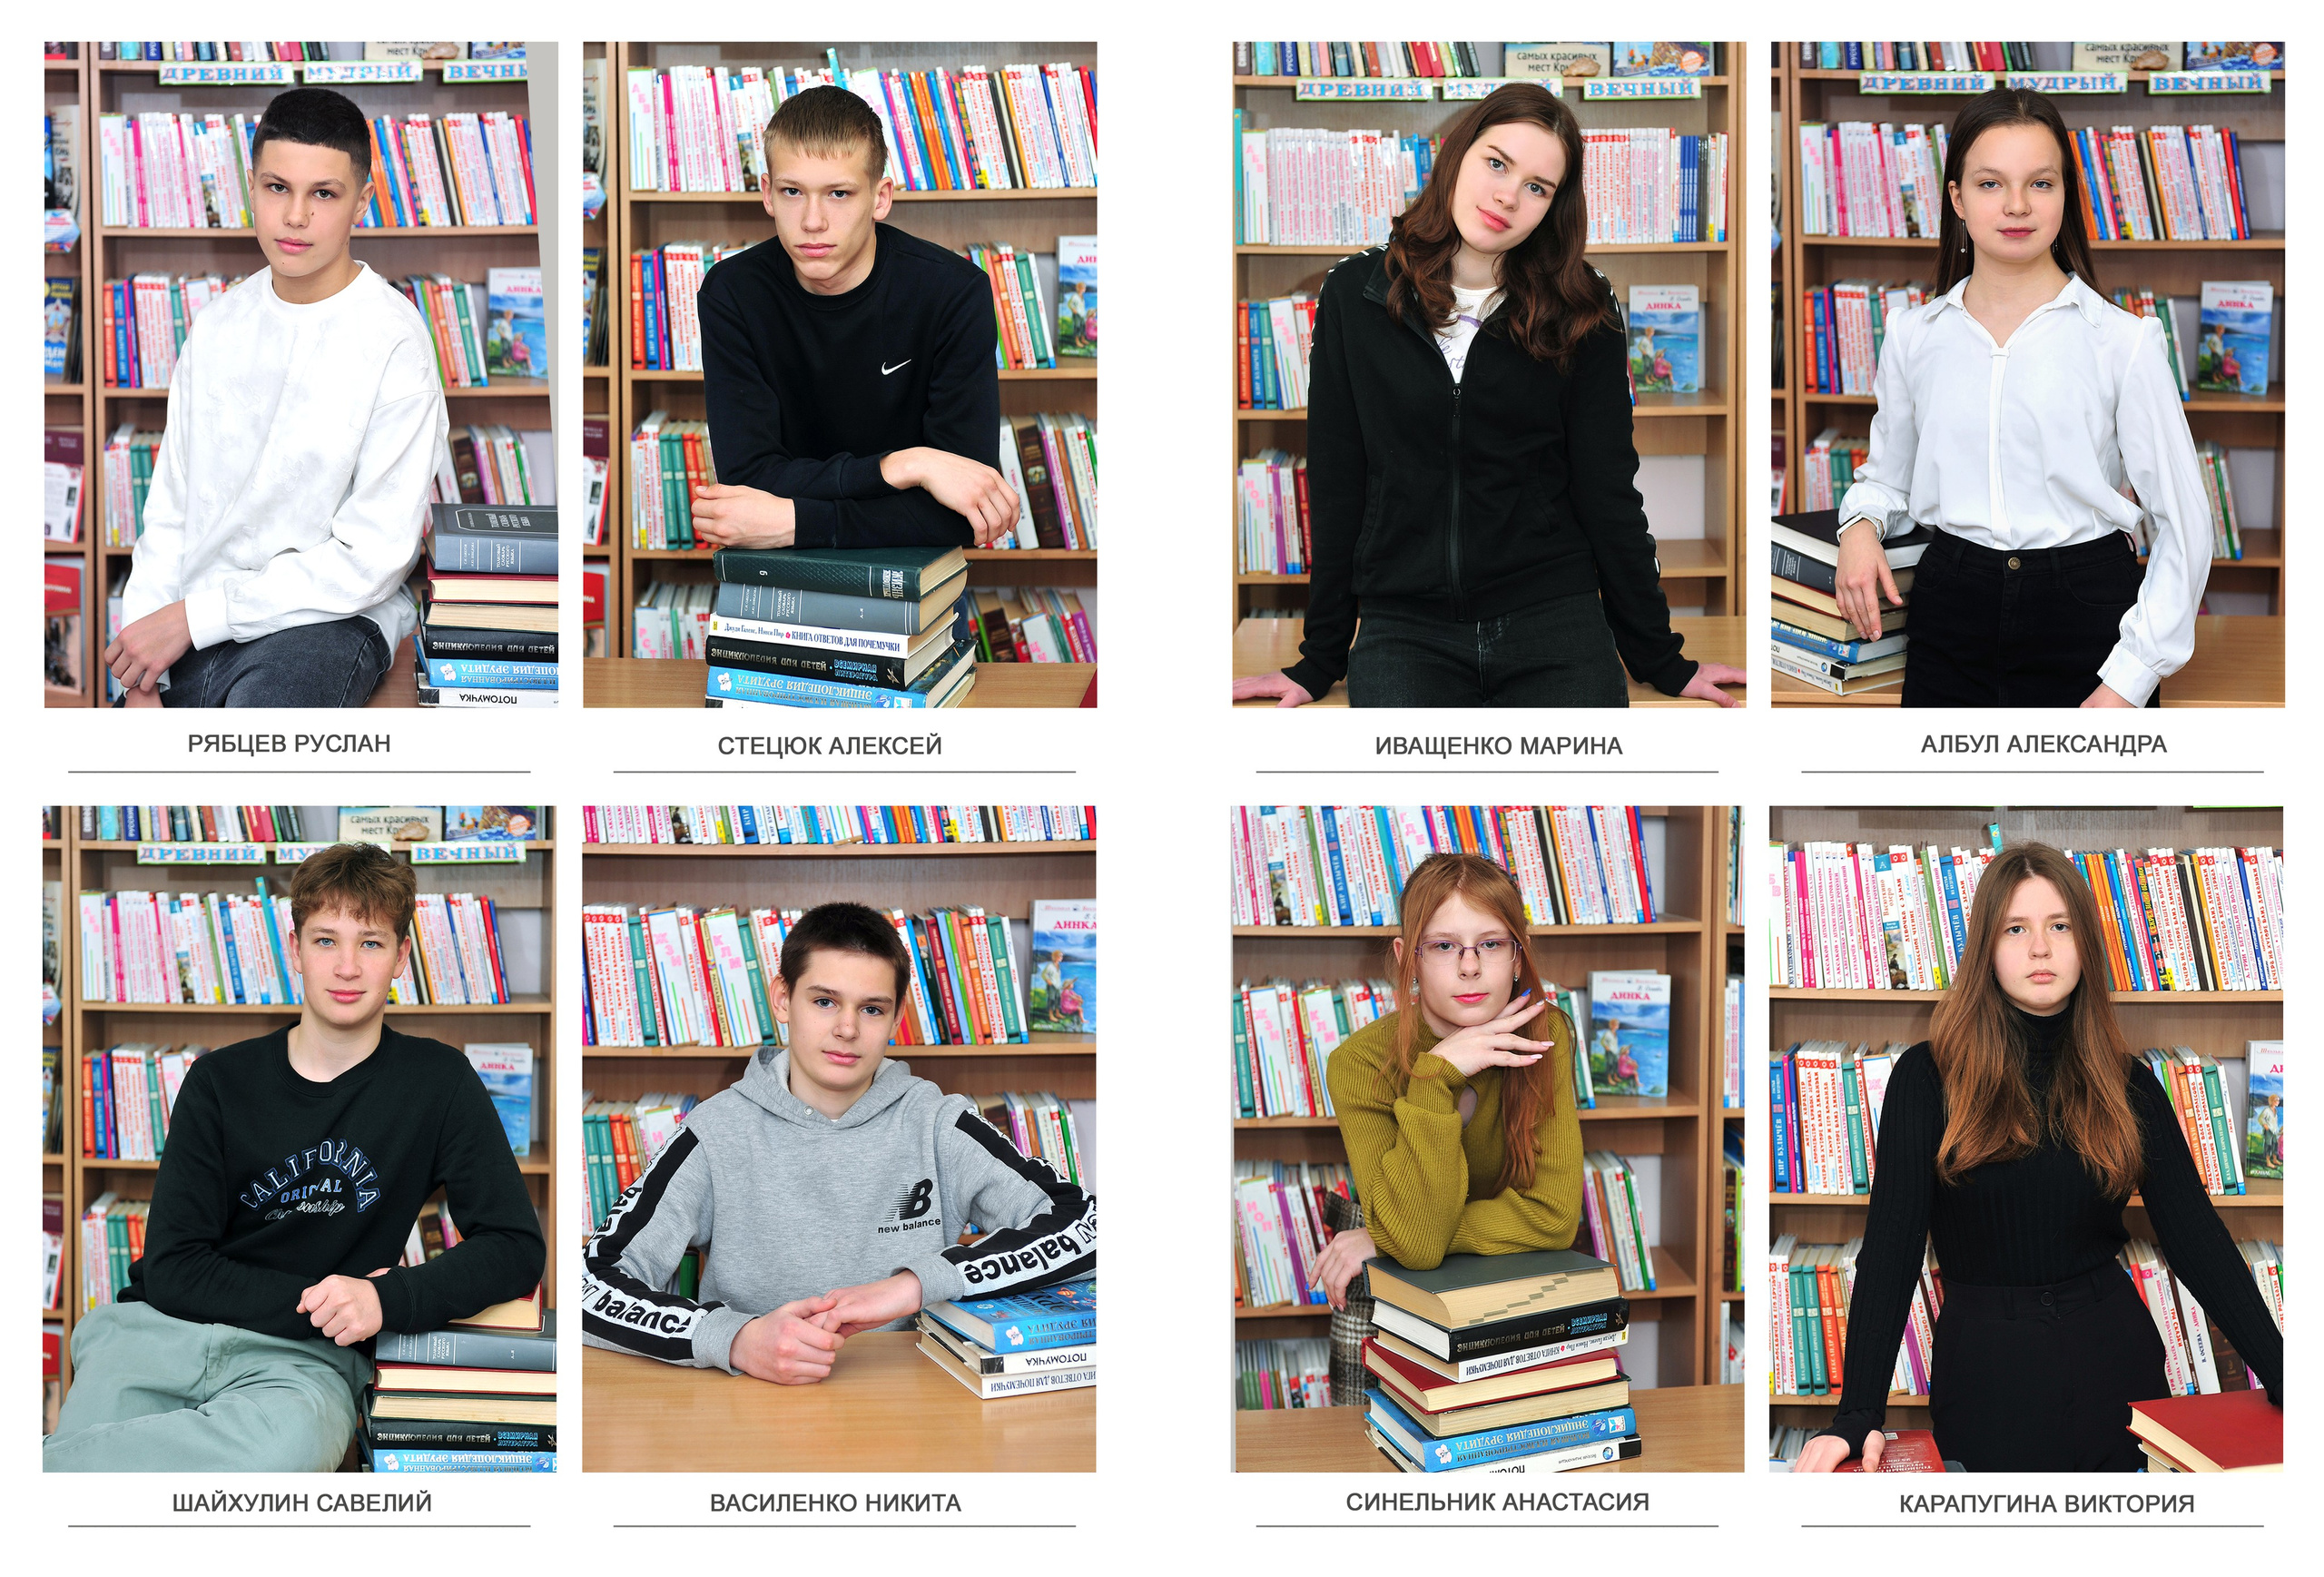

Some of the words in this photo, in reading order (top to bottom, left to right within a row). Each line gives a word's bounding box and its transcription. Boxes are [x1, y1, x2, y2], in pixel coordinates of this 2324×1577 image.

[1516, 52, 1547, 61] самых
[1549, 52, 1597, 63] красивых
[2097, 54, 2123, 64] мест
[1528, 64, 1553, 72] мест
[1589, 79, 1694, 96] ВЕЧНЫЙ
[2153, 73, 2263, 92] ВЕЧНЫЙ
[2218, 301, 2253, 309] ДИНКА
[891, 569, 904, 598] ЖИЗНЬ
[724, 623, 740, 631] Джуди
[741, 626, 756, 635] Галенс,
[758, 627, 773, 636] Нэнси
[773, 630, 784, 638] Пир
[792, 631, 813, 642] КНИГА
[814, 634, 844, 646] ОТВЕТОВ
[844, 638, 859, 647] ДЛЯ
[859, 640, 900, 652] ПОЧЕМУЧКИ
[432, 642, 503, 652] ЭНЦИКЛОПЕДИЯ
[528, 645, 555, 654] ДЕТЕЙ
[711, 648, 777, 665] ЭНЦИКЛОПЕДИЯ
[781, 658, 798, 666] ДЛЯ
[801, 660, 827, 671] ДЕТЕЙ
[834, 659, 877, 673] ВСЕМИРНАЯ
[461, 664, 509, 674] ЭРУДИТА
[835, 668, 878, 681] ЛИТЕРАТУРА
[461, 675, 556, 685] ИЛЛЮСТРИРОВАННАЯ
[737, 675, 783, 689] ЭРУДИТА
[735, 686, 827, 705] ИЛЛЮСТРИРОВАННАЯ
[787, 681, 872, 700] ЭНЦИКЛОПЕДИЯ
[459, 694, 517, 704] ПОТОМУЧКА
[352, 816, 382, 825] самых
[385, 815, 429, 826] красивых
[362, 827, 387, 835] мест
[141, 844, 263, 862] ДРЕВНИЙ,
[415, 843, 519, 862] ВЕЧНЫЙ
[2137, 867, 2148, 891] ОБЕЗЬЯНКИ
[1841, 865, 1850, 908] ПРИКЛЮЧЕНИЙ
[2227, 875, 2237, 902] ВОЛНАМ
[1880, 880, 1889, 916] Васюткино
[1886, 888, 1895, 906] озеро
[2233, 904, 2239, 913] ПО
[1909, 910, 1917, 935] ЧТЕНИЕ
[2147, 910, 2157, 933] СЕКРЕТ
[2235, 915, 2244, 947] БЕГУЩАЯ
[1850, 944, 1858, 971] БУЛЫЧЁВ
[1610, 991, 1649, 1000] ДИНКА
[481, 1062, 515, 1070] ДИНКА
[1775, 1119, 1784, 1156] БУЛЫЧЁВ
[878, 1225, 900, 1234] new
[902, 1218, 940, 1231] balance
[964, 1234, 1081, 1284] balance
[1571, 1313, 1607, 1326] ВСЕМИРНАЯ
[2191, 1306, 2200, 1326] ДИНКА
[1028, 1320, 1078, 1334] ЭРУДИТА
[1571, 1322, 1607, 1335] ЛИТЕРАТУРА
[2173, 1322, 2182, 1346] СКАЗКИ
[1457, 1334, 1521, 1353] ЭНЦИКЛОПЕДИЯ
[1524, 1331, 1539, 1340] ДЛЯ
[1542, 1324, 1564, 1336] ДЕТЕЙ
[1603, 1334, 1616, 1342] Джуди
[2197, 1334, 2205, 1355] ОСЕЕВА
[1515, 1349, 1541, 1363] ОТВЕТОВ
[1541, 1345, 1560, 1355] КНИГА
[1026, 1353, 1087, 1366] ПОТОМУЧКА
[1503, 1355, 1515, 1366] ДЛЯ
[1828, 1339, 1837, 1379] АЛЕКСАНДР
[1466, 1359, 1502, 1375] ПОЧЕМУЧКИ
[990, 1379, 1035, 1392] ПОЧЕМУЧКИ
[1036, 1375, 1049, 1386] ДЛЯ
[1051, 1373, 1082, 1385] ОТВЕТОВ
[497, 1432, 538, 1440] ВСЕМИРНАЯ
[1506, 1419, 1589, 1441] ЭНЦИКЛОПЕДИЯ
[377, 1433, 442, 1442] ЭНЦИКЛОПЕДИЯ
[467, 1434, 491, 1443] ДЕТЕЙ
[1455, 1434, 1503, 1451] ЭРУДИТА
[1551, 1432, 1590, 1445] БОЛЬШАЯ
[1457, 1440, 1548, 1462] ИЛЛЮСТРИРОВАННАЯ
[403, 1454, 448, 1464] ЭРУДИТА
[451, 1454, 532, 1464] ЭНЦИКЛОПЕДИЯ
[404, 1464, 490, 1473] ИЛЛЮСТРИРОВАННАЯ
